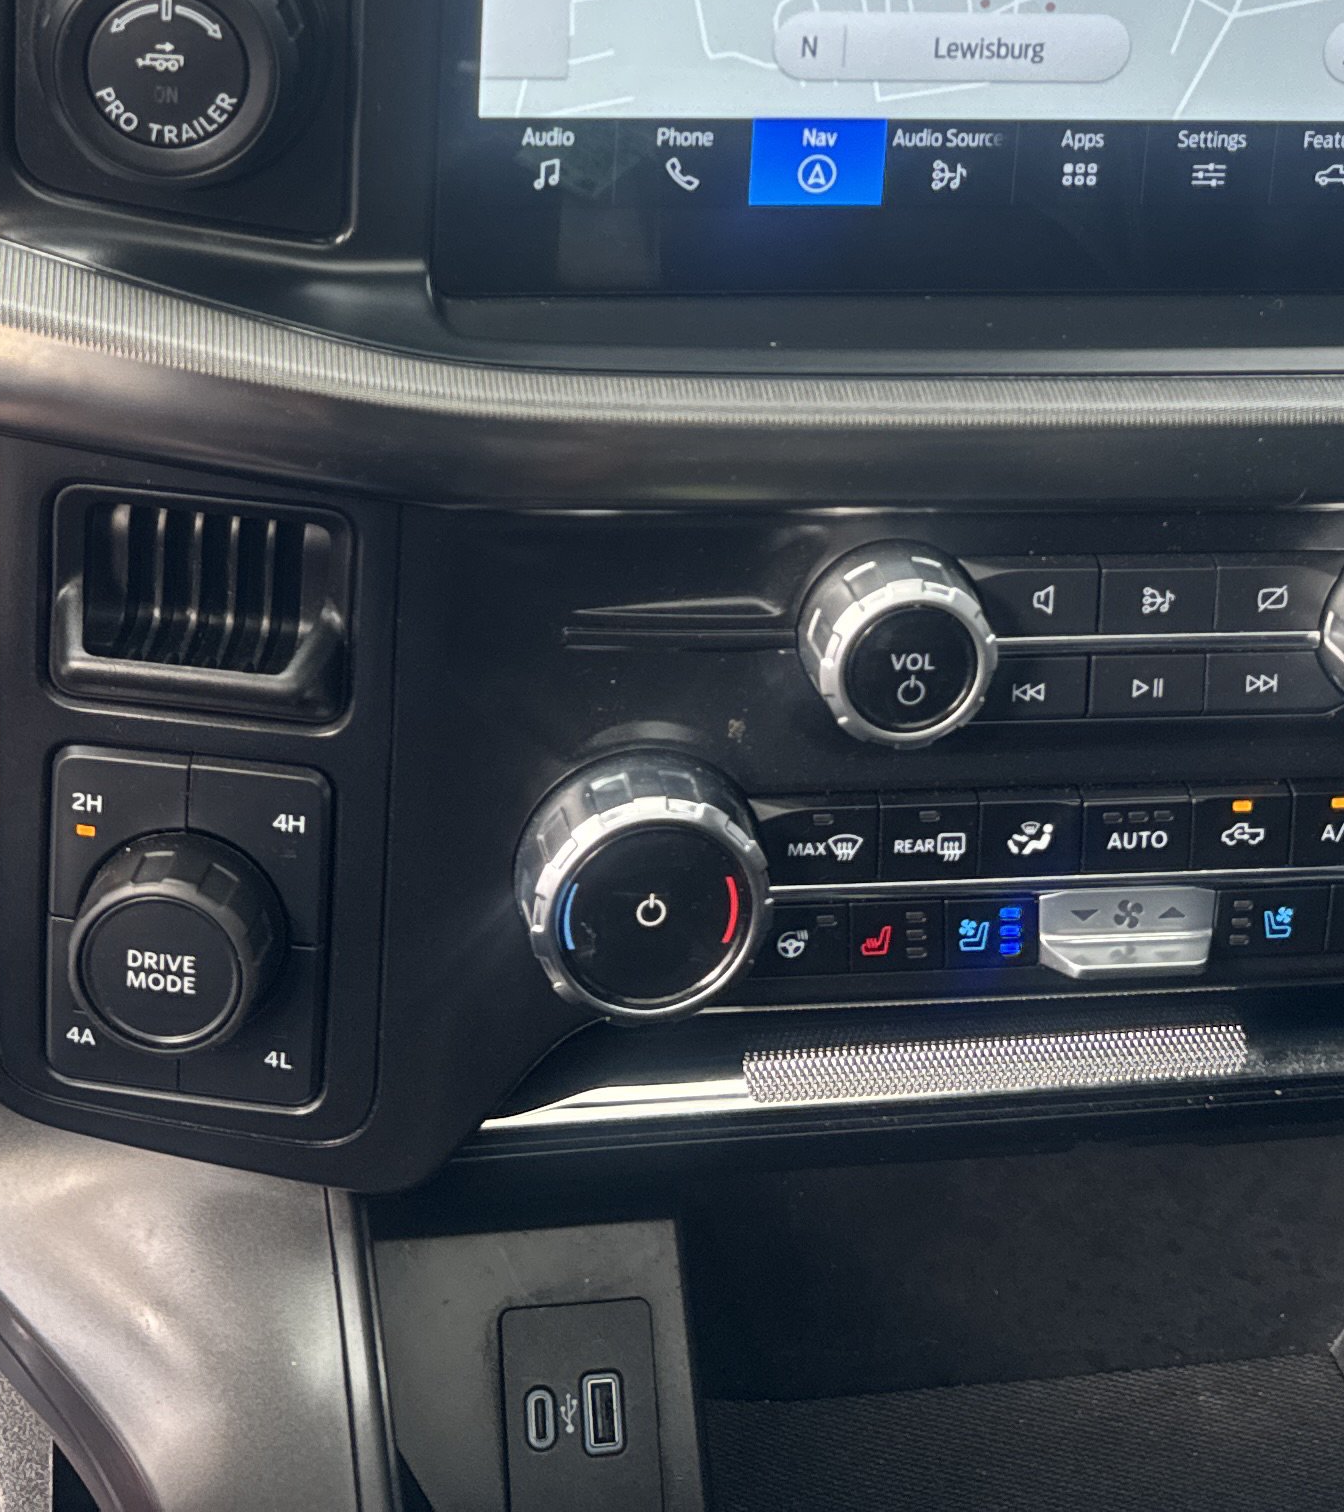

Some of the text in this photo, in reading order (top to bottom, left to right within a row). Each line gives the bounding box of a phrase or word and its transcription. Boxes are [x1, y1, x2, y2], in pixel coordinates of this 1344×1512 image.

[801, 36, 818, 59] N
[933, 36, 1046, 64] Lewisburg
[95, 86, 238, 145] PRO TRAILER
[521, 126, 576, 148] Audio
[656, 127, 714, 148] Phone
[801, 128, 838, 148] Nav
[892, 128, 943, 148] Audio
[1060, 129, 1105, 152] Apps
[1177, 129, 1247, 152] Settings
[890, 651, 936, 673] VOL
[71, 791, 103, 814] 2H
[271, 813, 306, 835] 4H
[787, 840, 827, 858] MAX
[893, 837, 936, 855] REAR
[1107, 830, 1168, 850] AUTO
[126, 948, 197, 975] DRIVE
[125, 969, 197, 996] MODE
[66, 1025, 97, 1047] 4A
[263, 1050, 293, 1071] 4L
